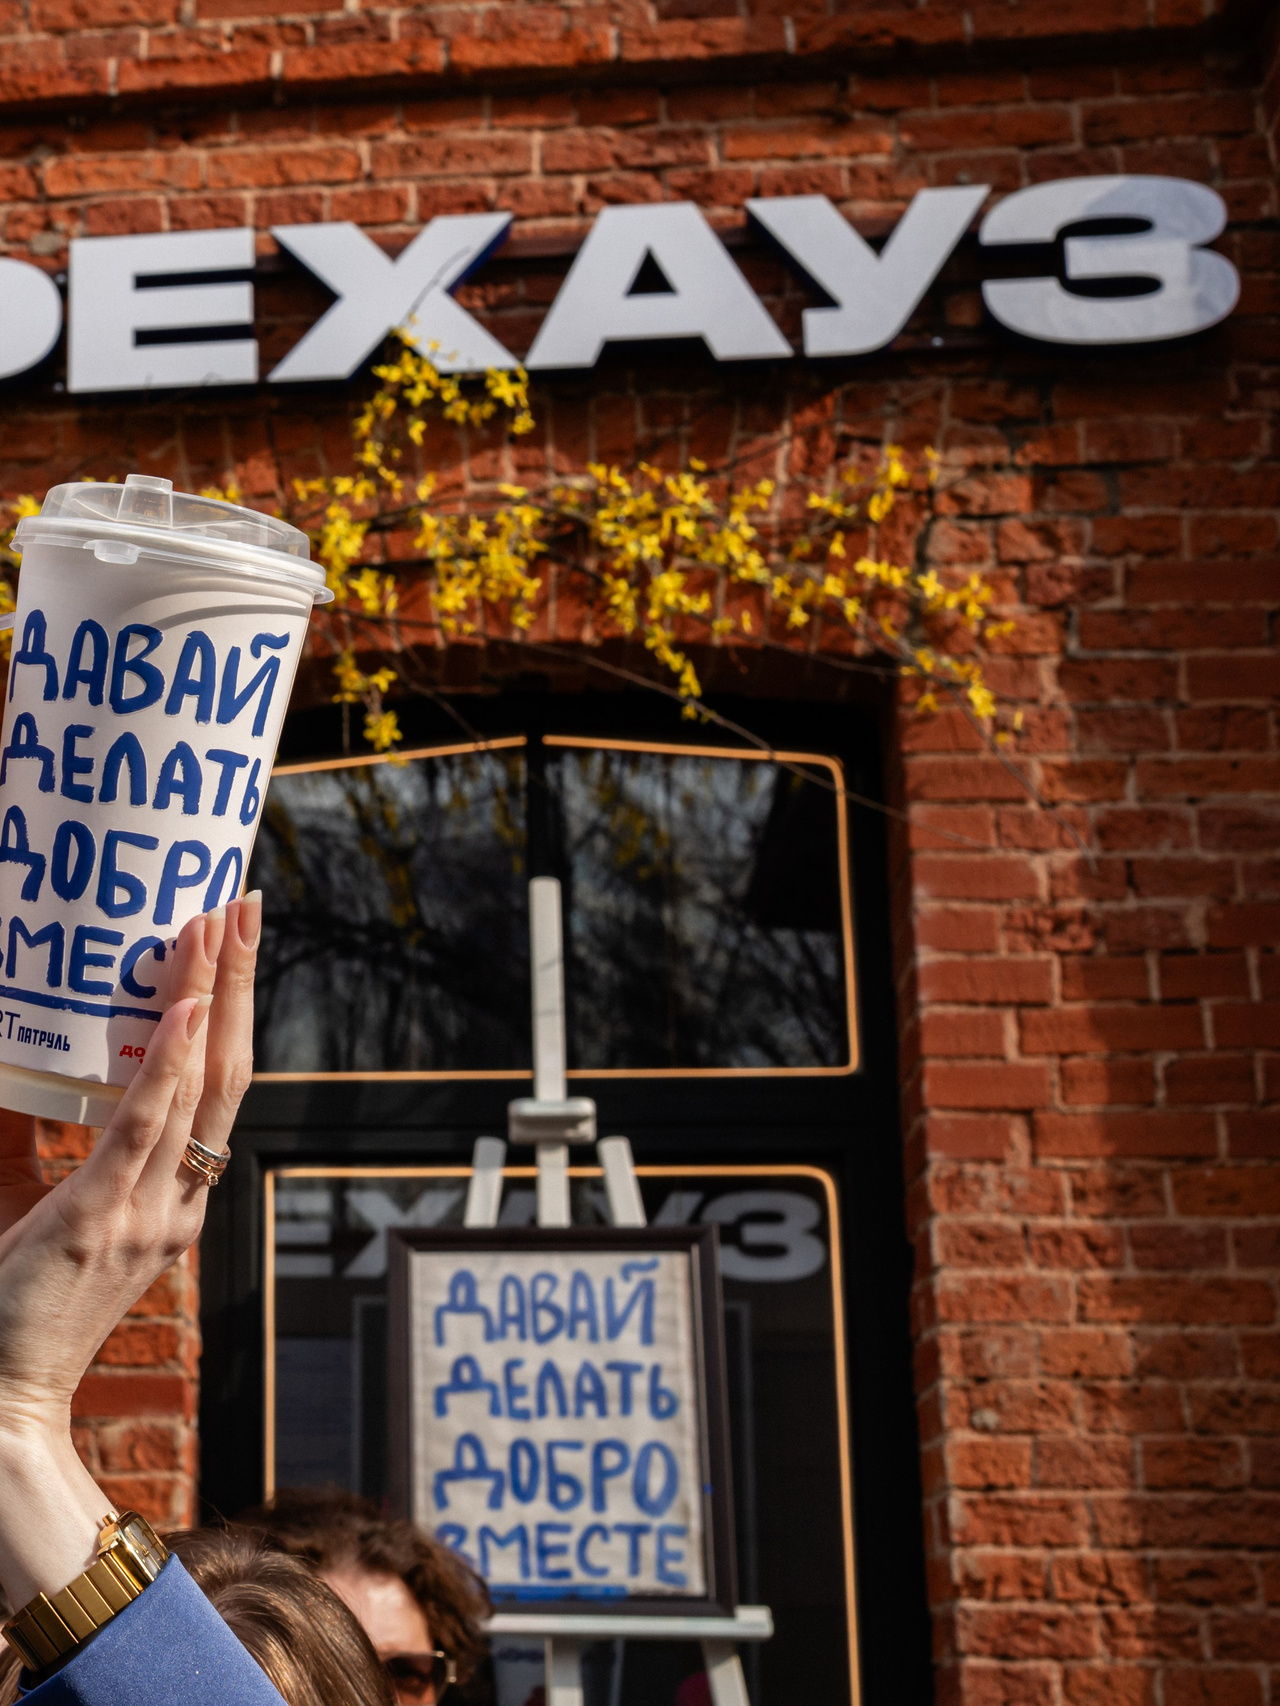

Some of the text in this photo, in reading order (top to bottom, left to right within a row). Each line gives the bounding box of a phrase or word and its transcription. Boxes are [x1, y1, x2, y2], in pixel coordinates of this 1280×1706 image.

[8, 608, 291, 738] ДАВАЙ
[17, 1025, 71, 1052] ПАТРУЛЬ
[433, 1257, 660, 1347] ДАВАЙ
[433, 1354, 680, 1422] ДЕЛАТЬ
[431, 1432, 680, 1519] ДОБРО
